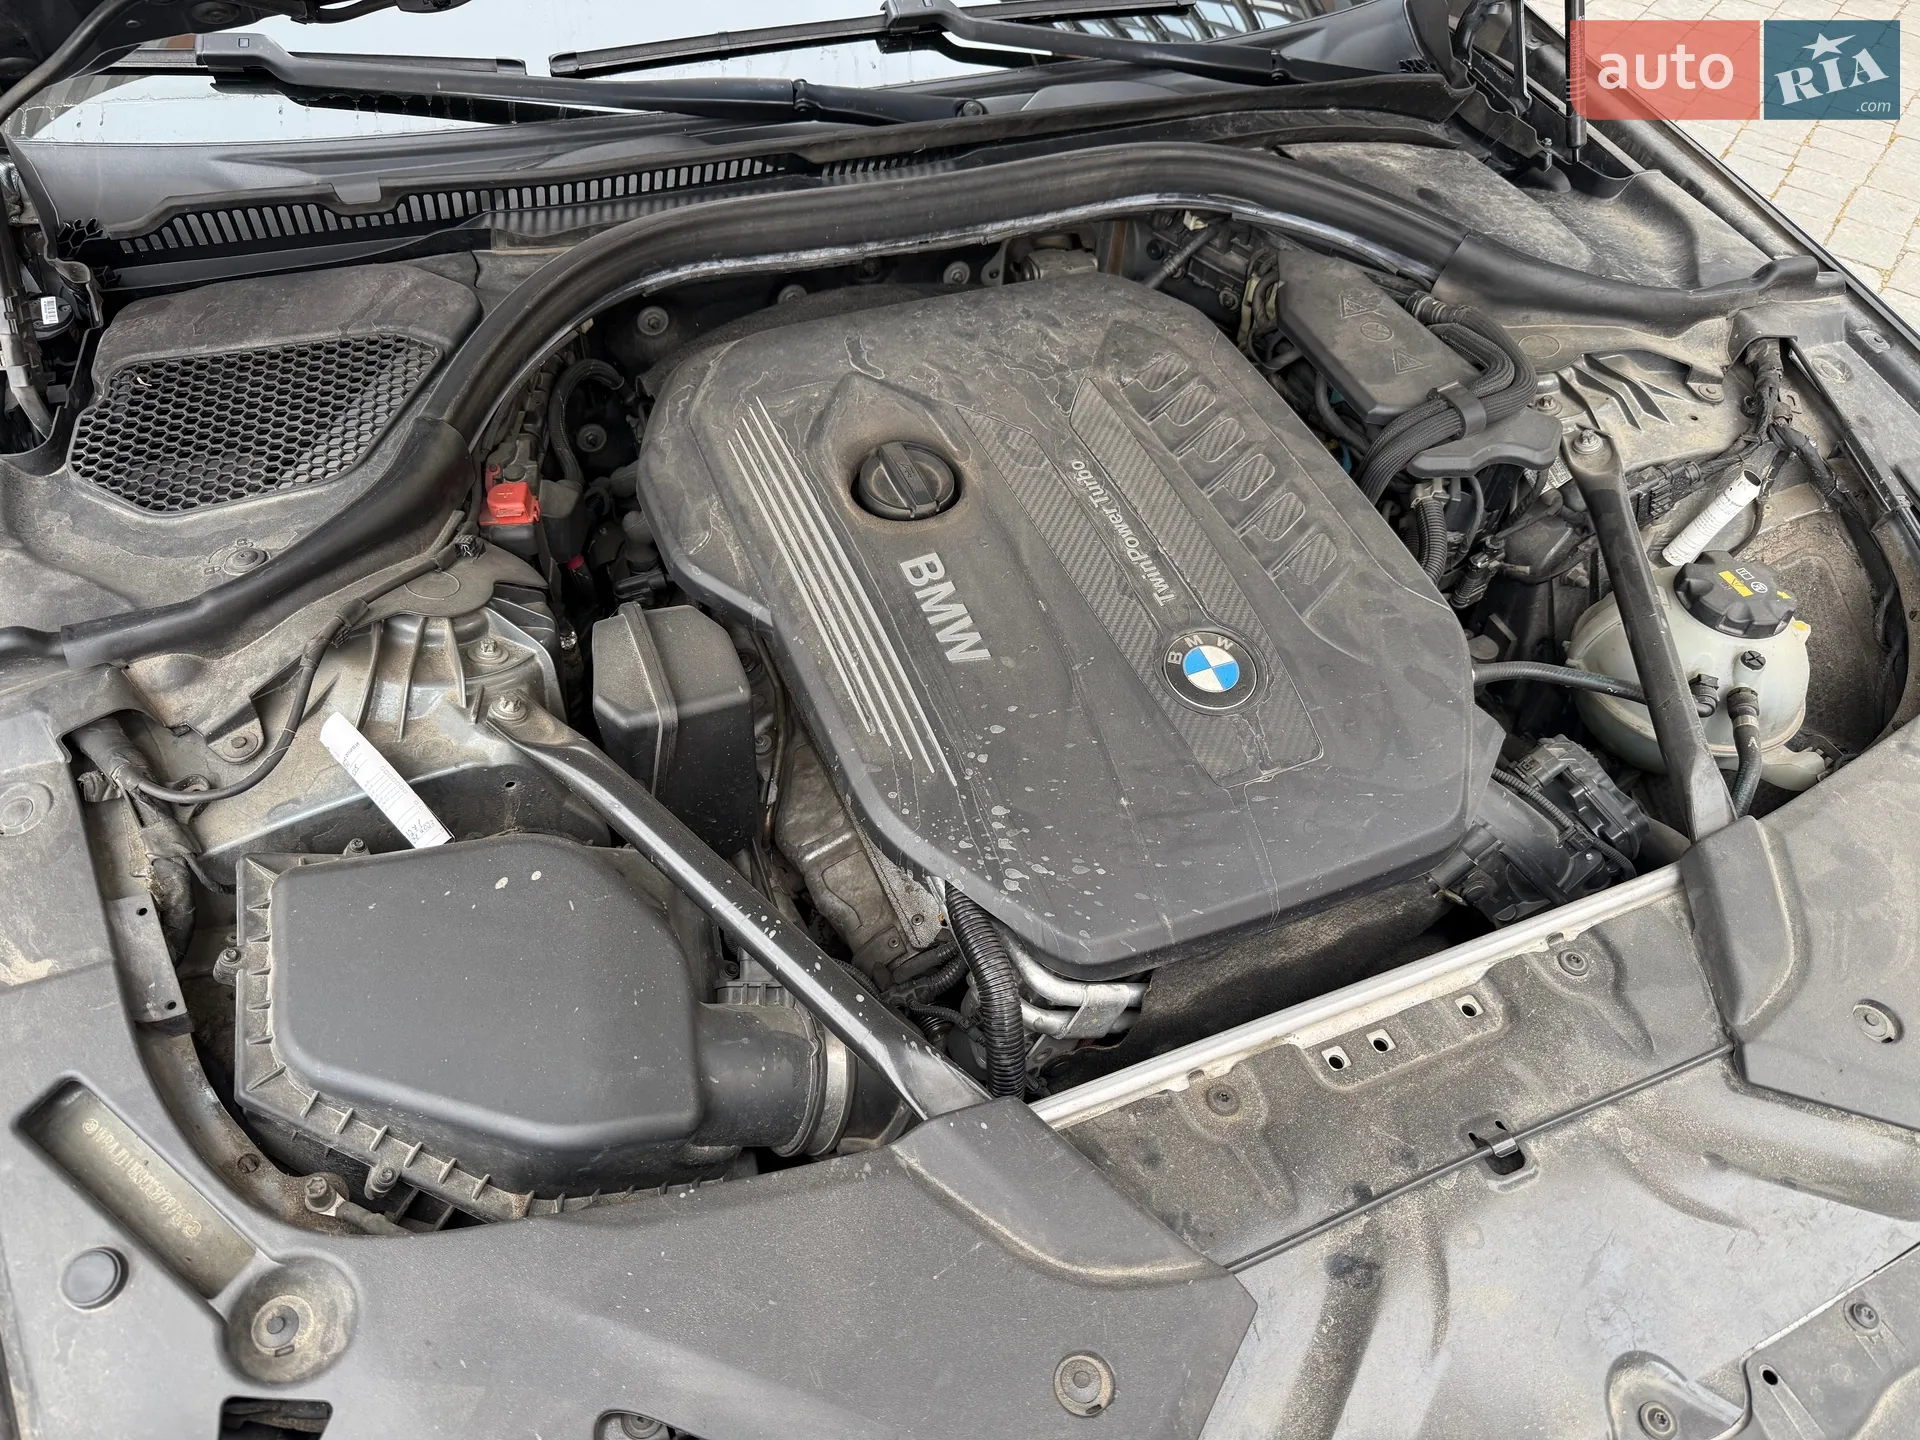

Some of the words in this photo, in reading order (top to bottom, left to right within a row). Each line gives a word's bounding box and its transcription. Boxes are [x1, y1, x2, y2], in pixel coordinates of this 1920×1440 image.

[1071, 460, 1110, 508] Turbo
[1102, 505, 1175, 607] TwinPower
[900, 552, 991, 664] BMW
[1167, 634, 1234, 665] BMW
